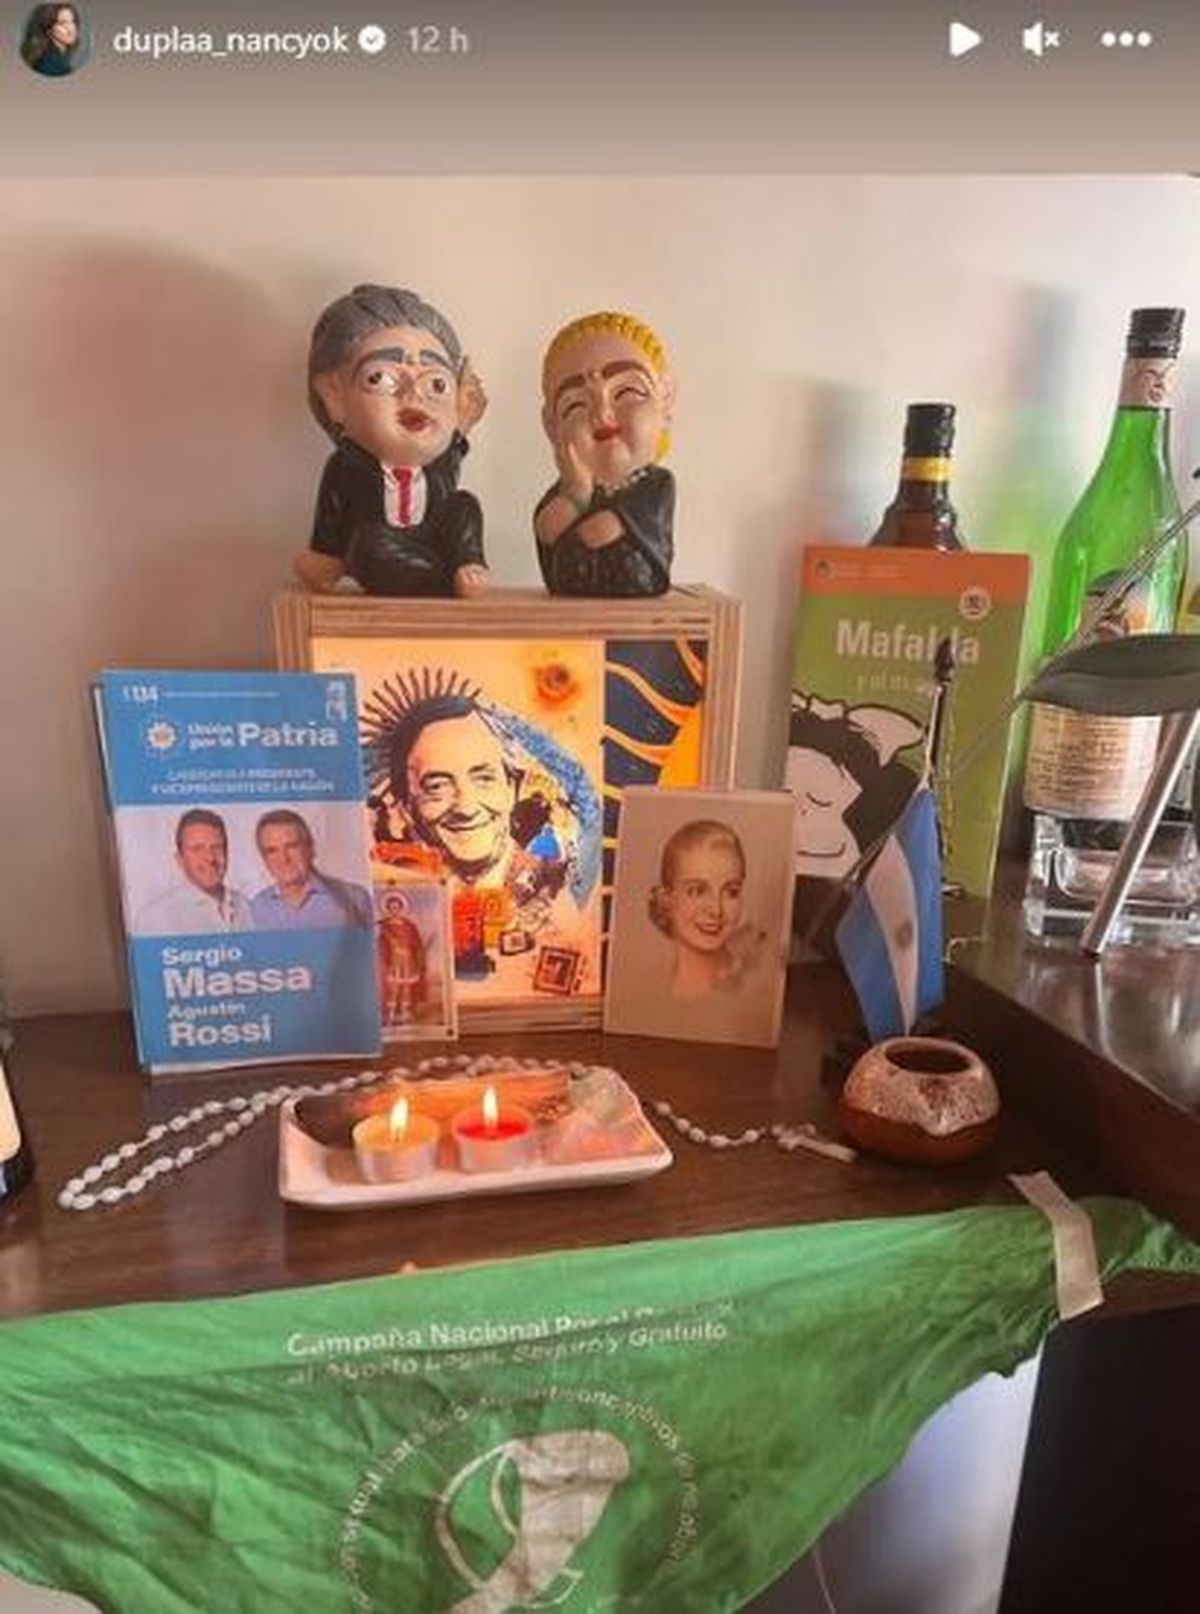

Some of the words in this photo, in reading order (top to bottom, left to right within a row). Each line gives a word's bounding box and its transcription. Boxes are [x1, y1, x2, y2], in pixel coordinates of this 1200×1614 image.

[238, 720, 340, 748] Patria
[161, 943, 243, 967] Sergio
[163, 965, 313, 1000] Massa
[168, 1013, 273, 1048] Rossi
[286, 1325, 422, 1357] Campaña
[429, 1317, 549, 1347] Nacional
[628, 1320, 728, 1347] Gratuito
